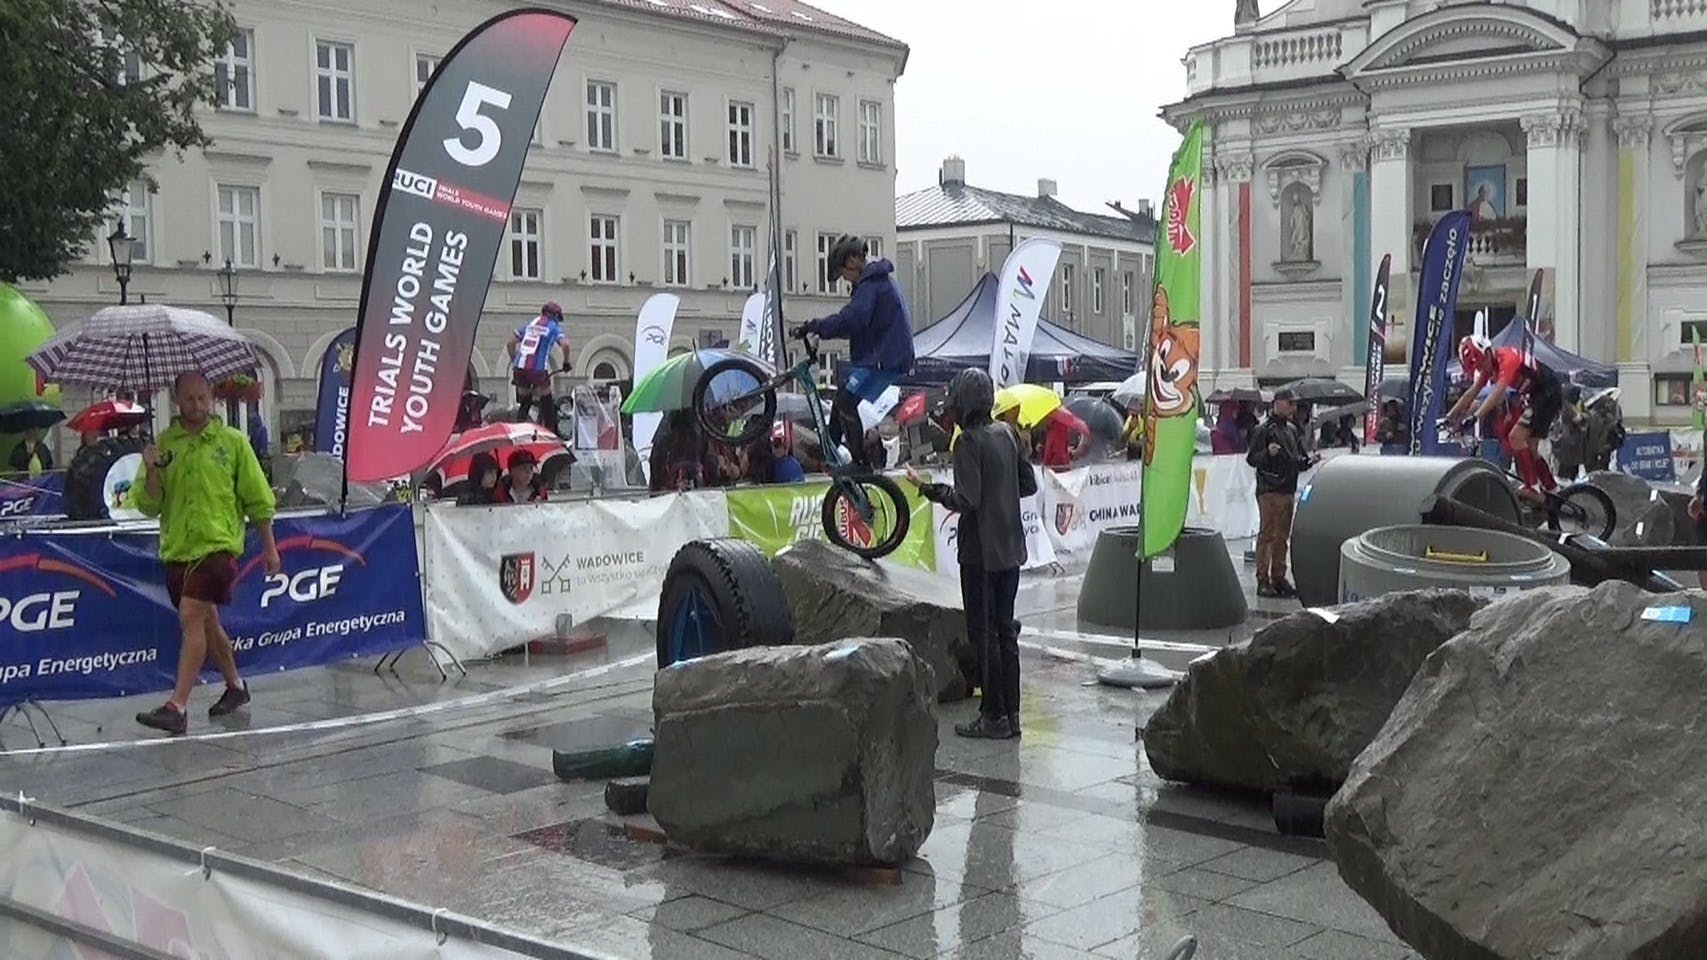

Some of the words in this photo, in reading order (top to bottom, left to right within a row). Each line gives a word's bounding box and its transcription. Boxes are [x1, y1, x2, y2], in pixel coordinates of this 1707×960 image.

[443, 81, 512, 166] 5
[400, 174, 433, 195] UCI
[437, 192, 461, 204] WORLD
[462, 199, 483, 211] YOUTH
[438, 184, 460, 196] TRIALS
[1441, 228, 1457, 304] zaczęło
[1376, 284, 1385, 320] 2
[368, 333, 407, 427] TRIALS
[389, 222, 433, 326] WORLD
[400, 338, 440, 433] YOUTH
[425, 230, 468, 334] GAMES
[332, 386, 349, 462] DOWICE
[1, 497, 35, 516] PGE
[576, 552, 644, 569] WADOWICE
[260, 564, 344, 608] PGE
[258, 627, 301, 646] Grupa
[306, 610, 405, 637] Energetyczna
[37, 647, 157, 676] Energetyczna
